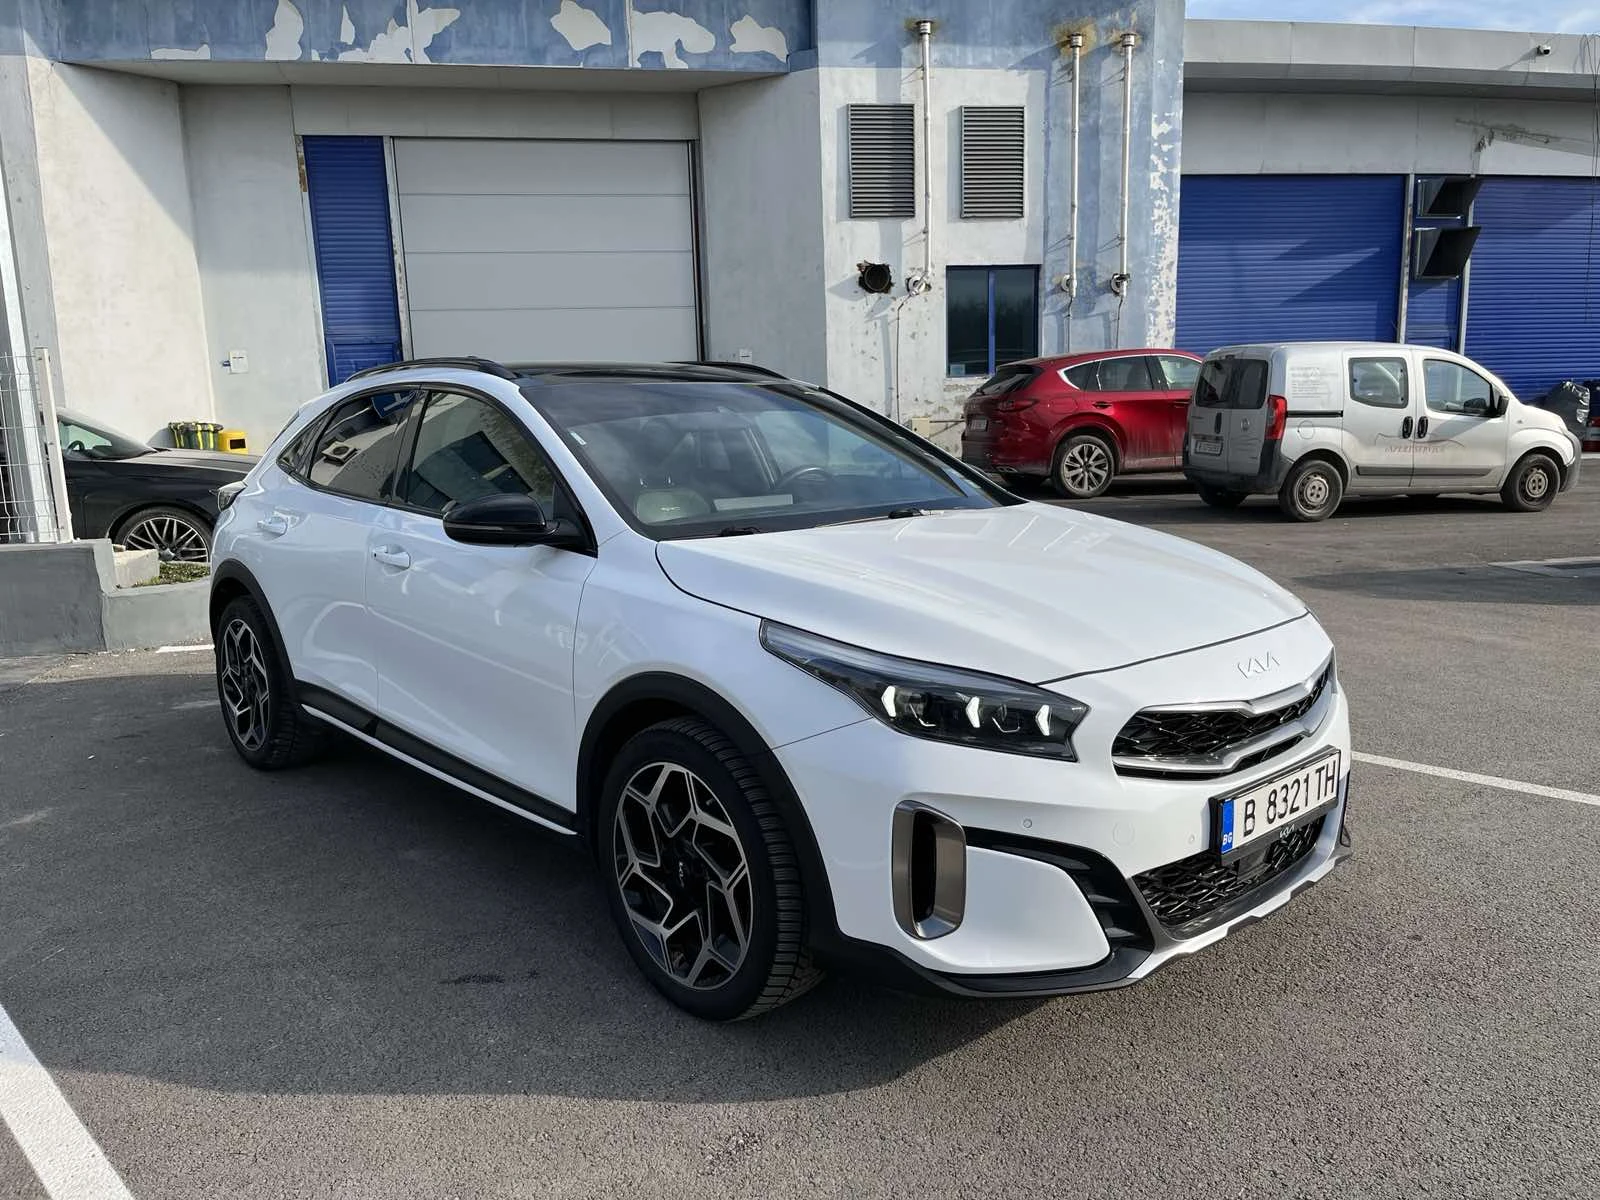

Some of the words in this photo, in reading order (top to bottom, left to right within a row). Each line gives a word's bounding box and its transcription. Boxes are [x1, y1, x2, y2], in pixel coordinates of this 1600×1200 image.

[1243, 798, 1256, 837] B
[1266, 772, 1310, 824] 8321
[1315, 760, 1336, 801] TH
[1222, 832, 1233, 846] BG
